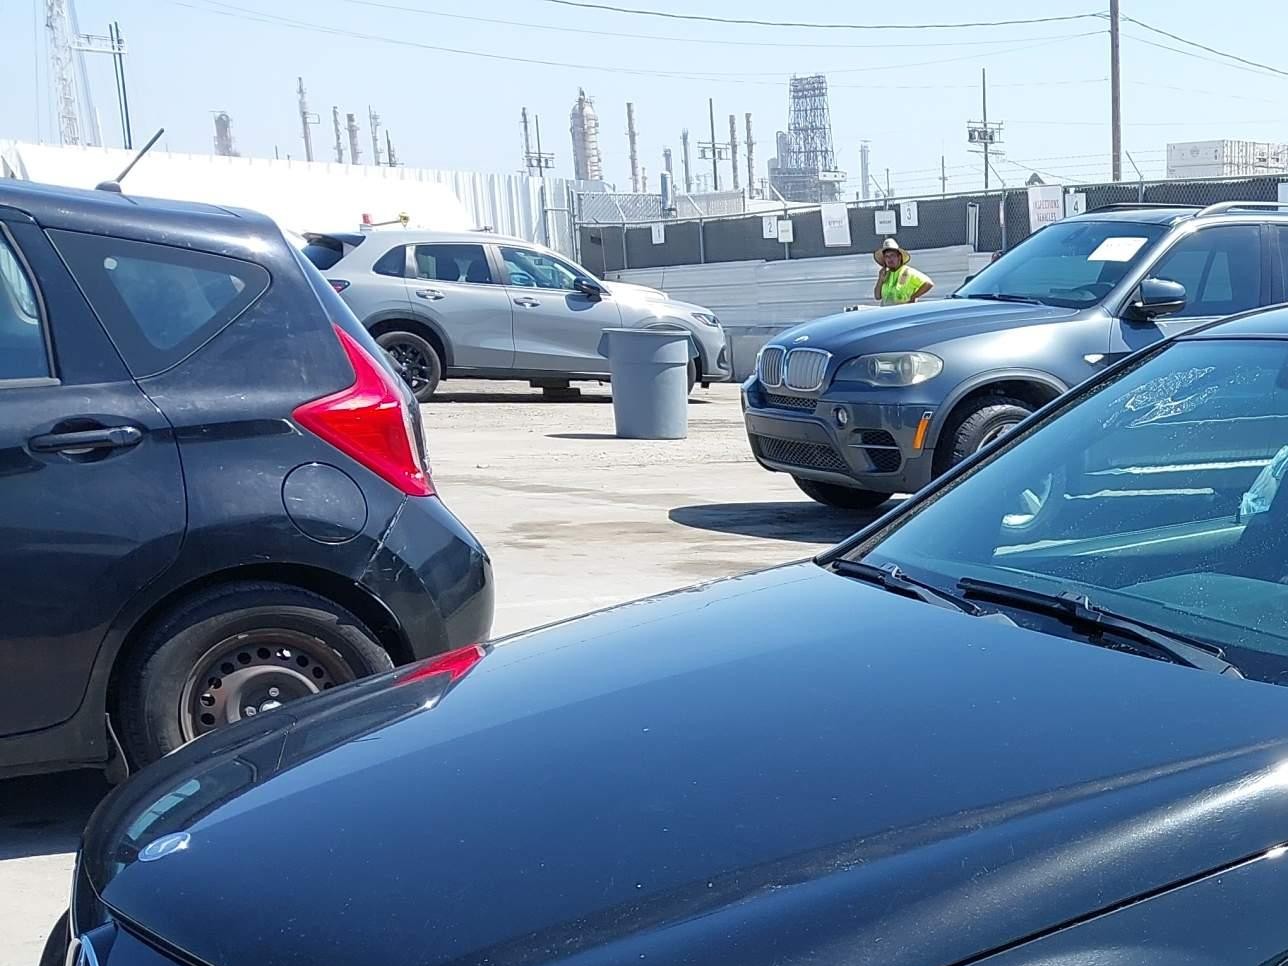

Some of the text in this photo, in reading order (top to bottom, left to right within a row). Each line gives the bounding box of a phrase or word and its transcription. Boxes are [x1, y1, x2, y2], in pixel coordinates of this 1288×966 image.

[1073, 200, 1080, 214] 4
[906, 208, 912, 221] 3
[767, 222, 774, 233] 2
